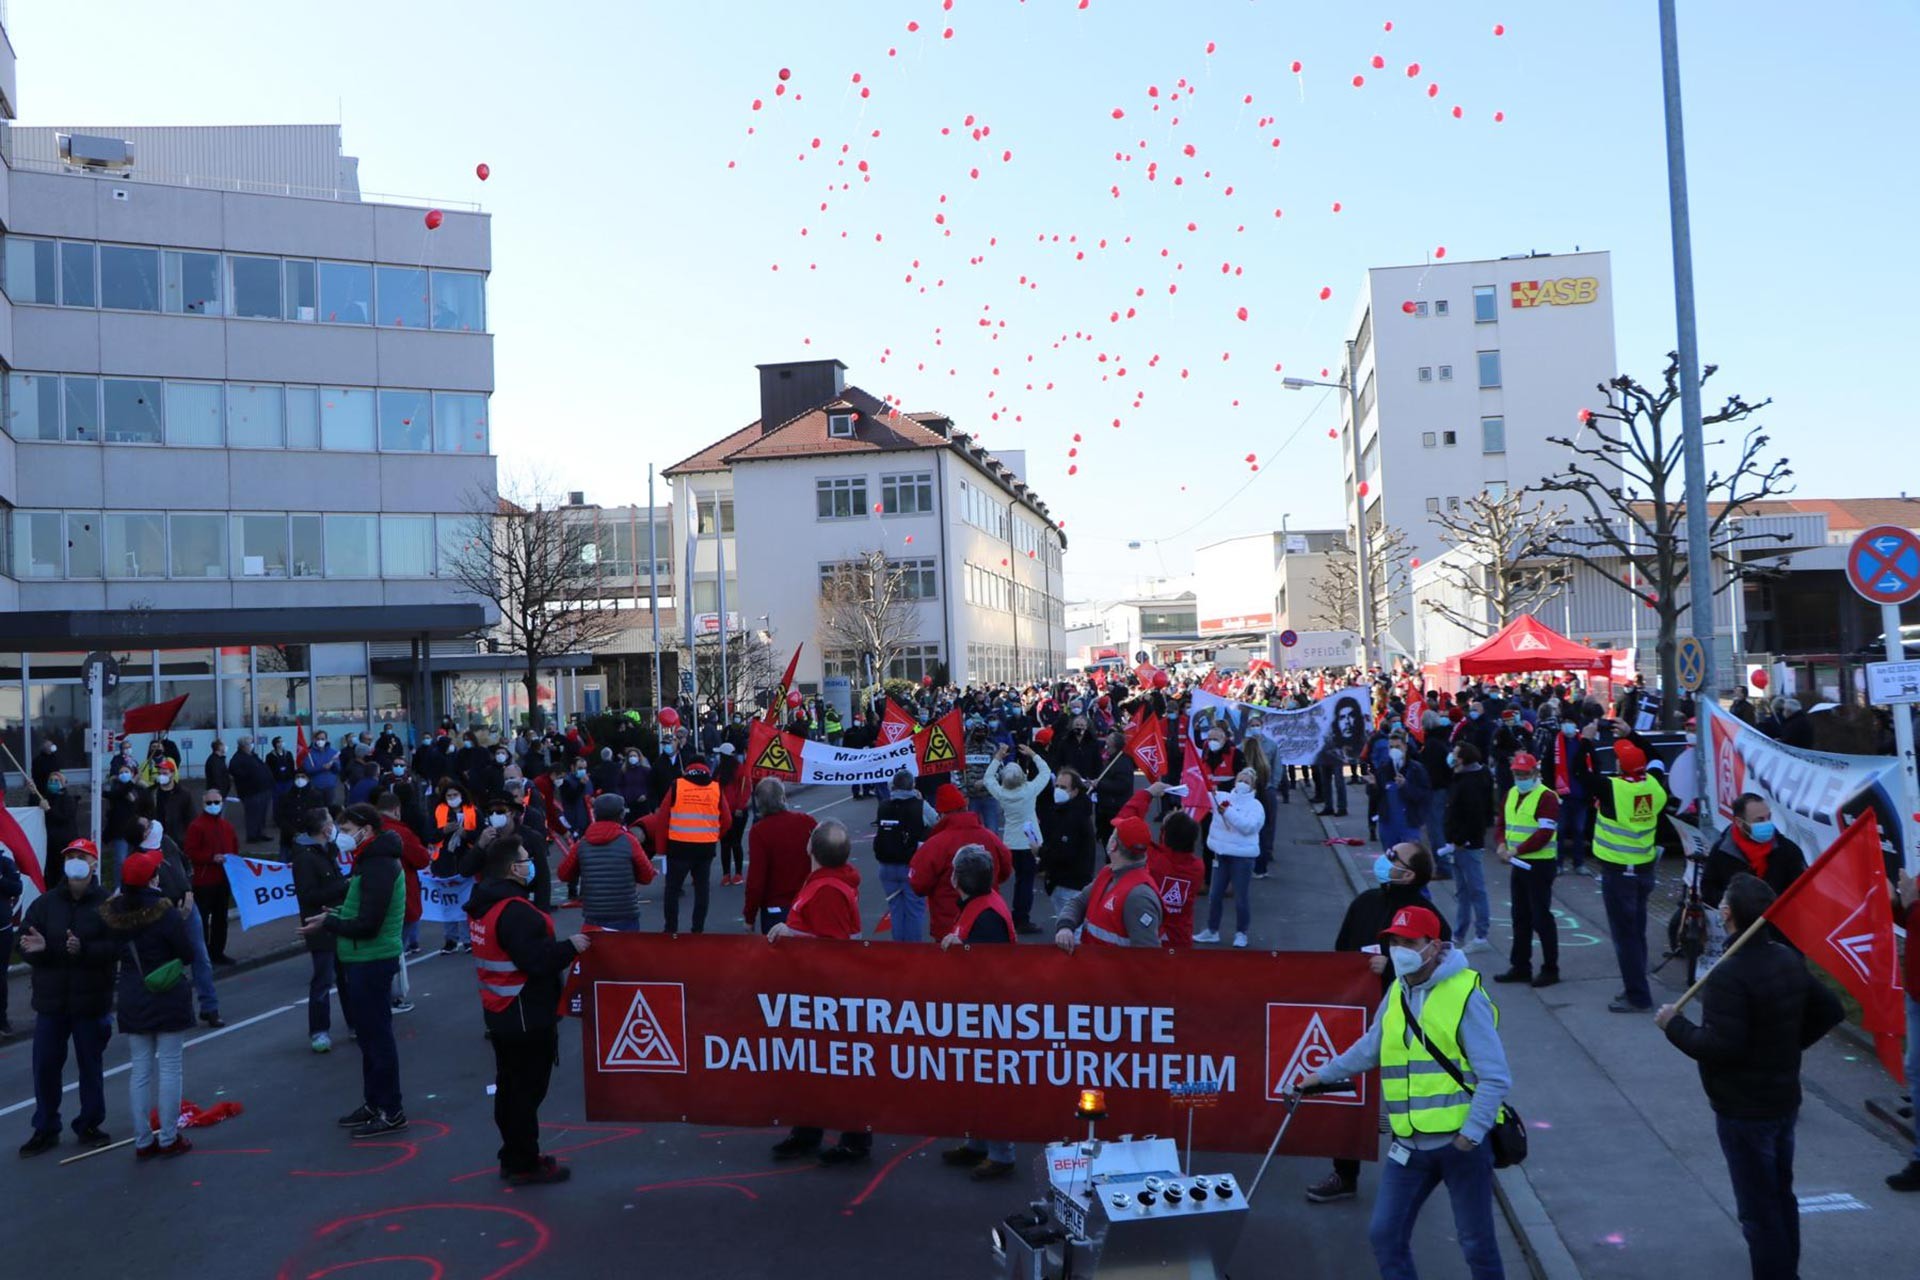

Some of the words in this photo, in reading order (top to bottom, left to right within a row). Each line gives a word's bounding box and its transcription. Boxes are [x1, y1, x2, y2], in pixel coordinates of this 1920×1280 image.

[1535, 276, 1598, 306] ASB
[1303, 646, 1347, 658] SPEIDEL
[757, 993, 1175, 1044] VERTRAUENSLEUTE
[704, 1035, 876, 1077] DAIMLER
[890, 1042, 1237, 1093] UNTERTÜRKHEIM
